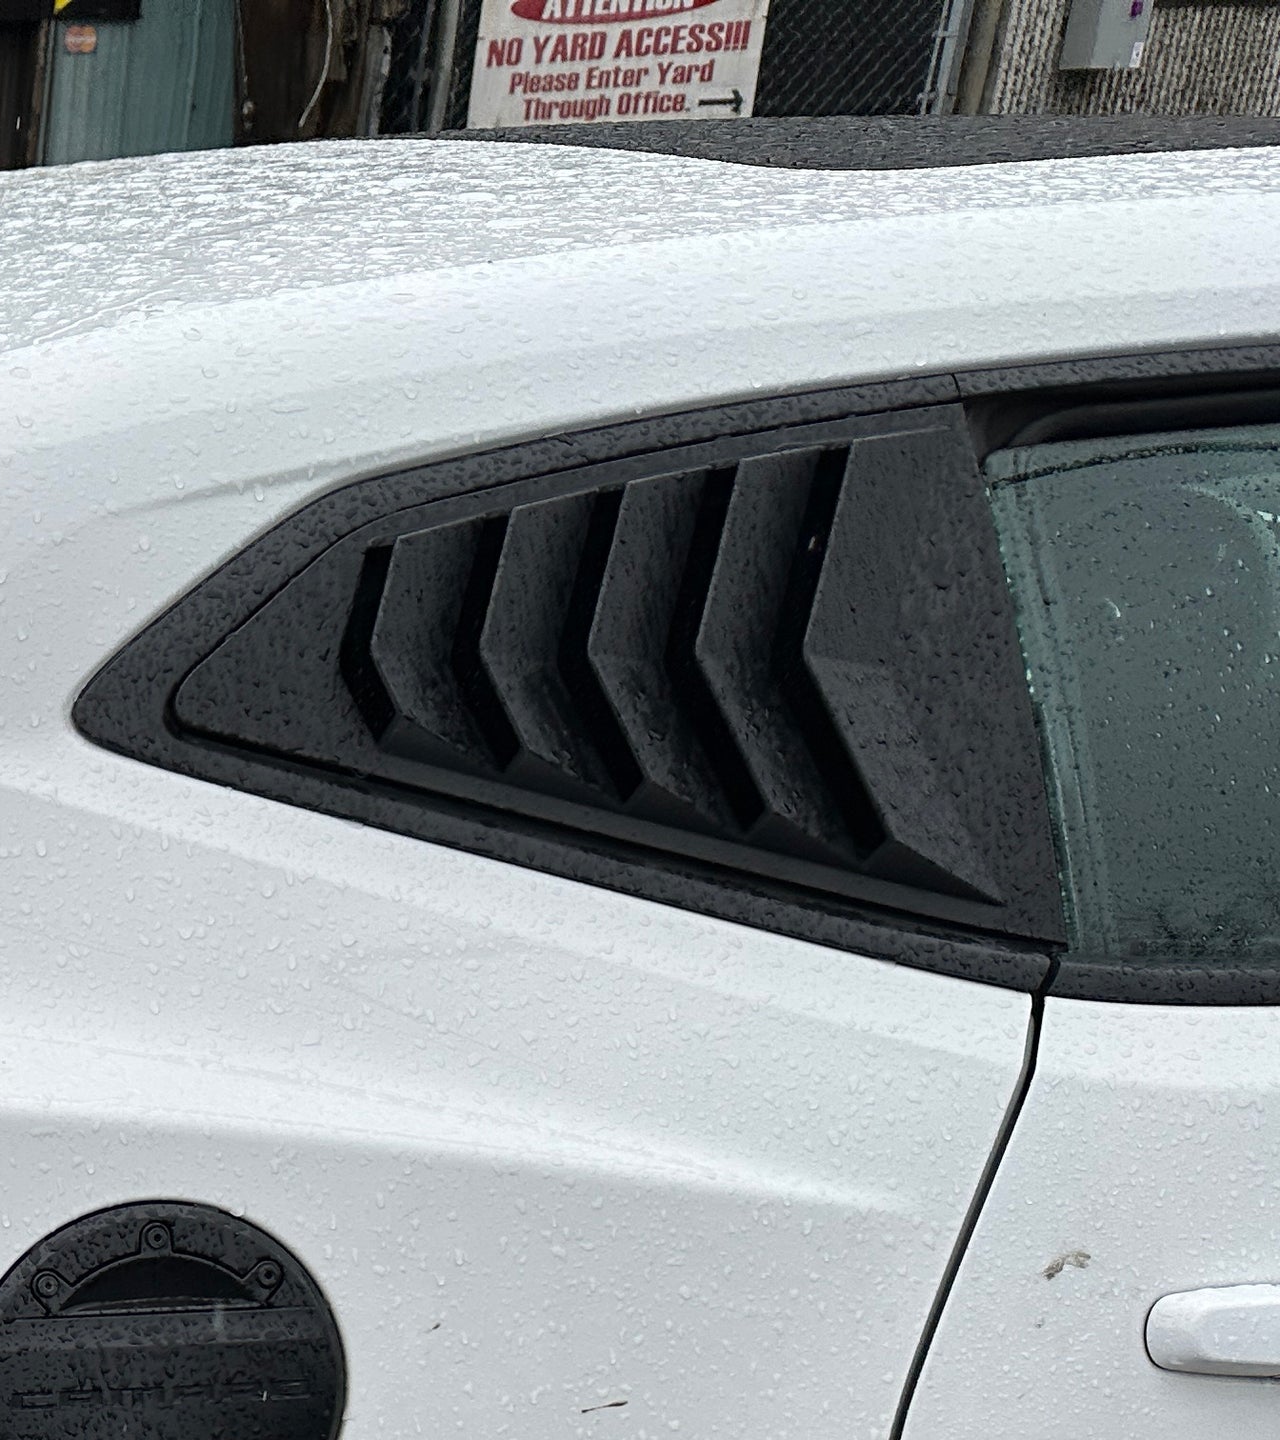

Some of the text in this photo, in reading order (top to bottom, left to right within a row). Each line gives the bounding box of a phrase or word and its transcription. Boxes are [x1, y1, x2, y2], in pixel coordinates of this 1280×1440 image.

[542, 0, 692, 19] ATTEN
[486, 20, 752, 68] NO YARD ACCESS!!!
[509, 59, 716, 95] Please Enter Yard
[523, 96, 611, 121] Through
